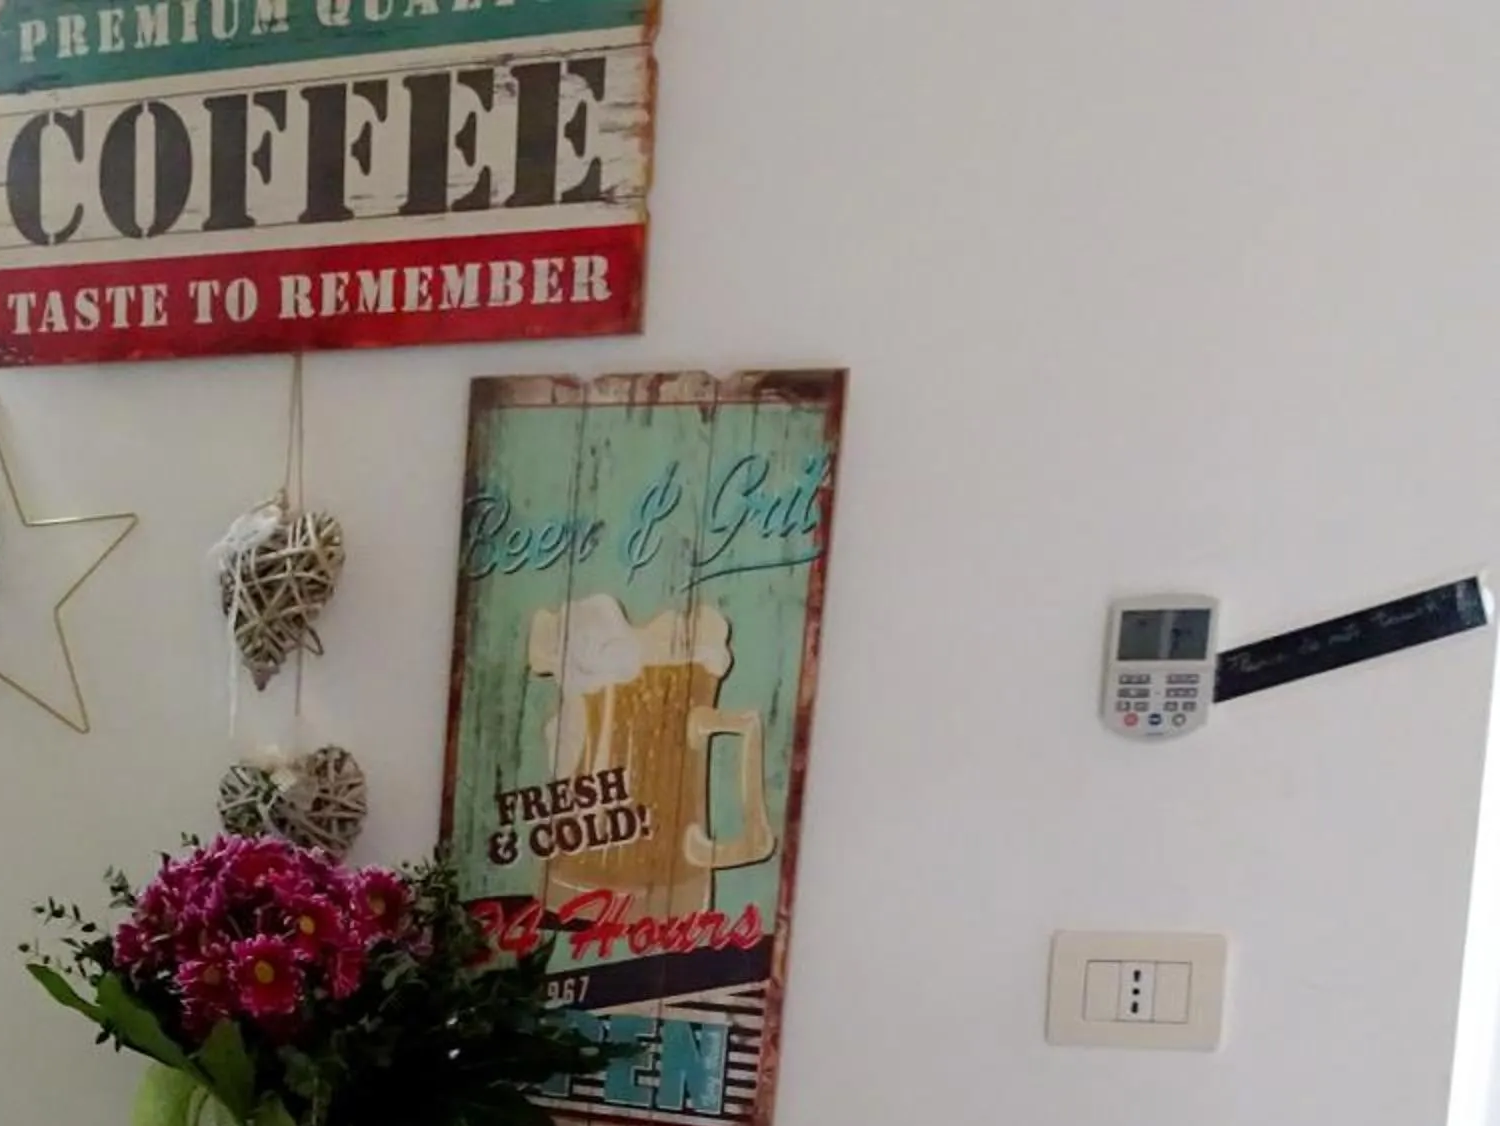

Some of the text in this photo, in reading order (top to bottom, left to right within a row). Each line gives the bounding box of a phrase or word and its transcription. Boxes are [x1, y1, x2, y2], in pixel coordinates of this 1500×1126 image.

[18, 0, 289, 63] PREMIUM
[6, 57, 607, 246] COFFEE
[7, 255, 613, 336] TASTE TO REMEMBER
[462, 486, 606, 581] Beer
[486, 803, 653, 866] & COLD!
[495, 767, 630, 827] FRESH
[553, 888, 765, 960] Hours
[540, 1009, 729, 1116] EN
